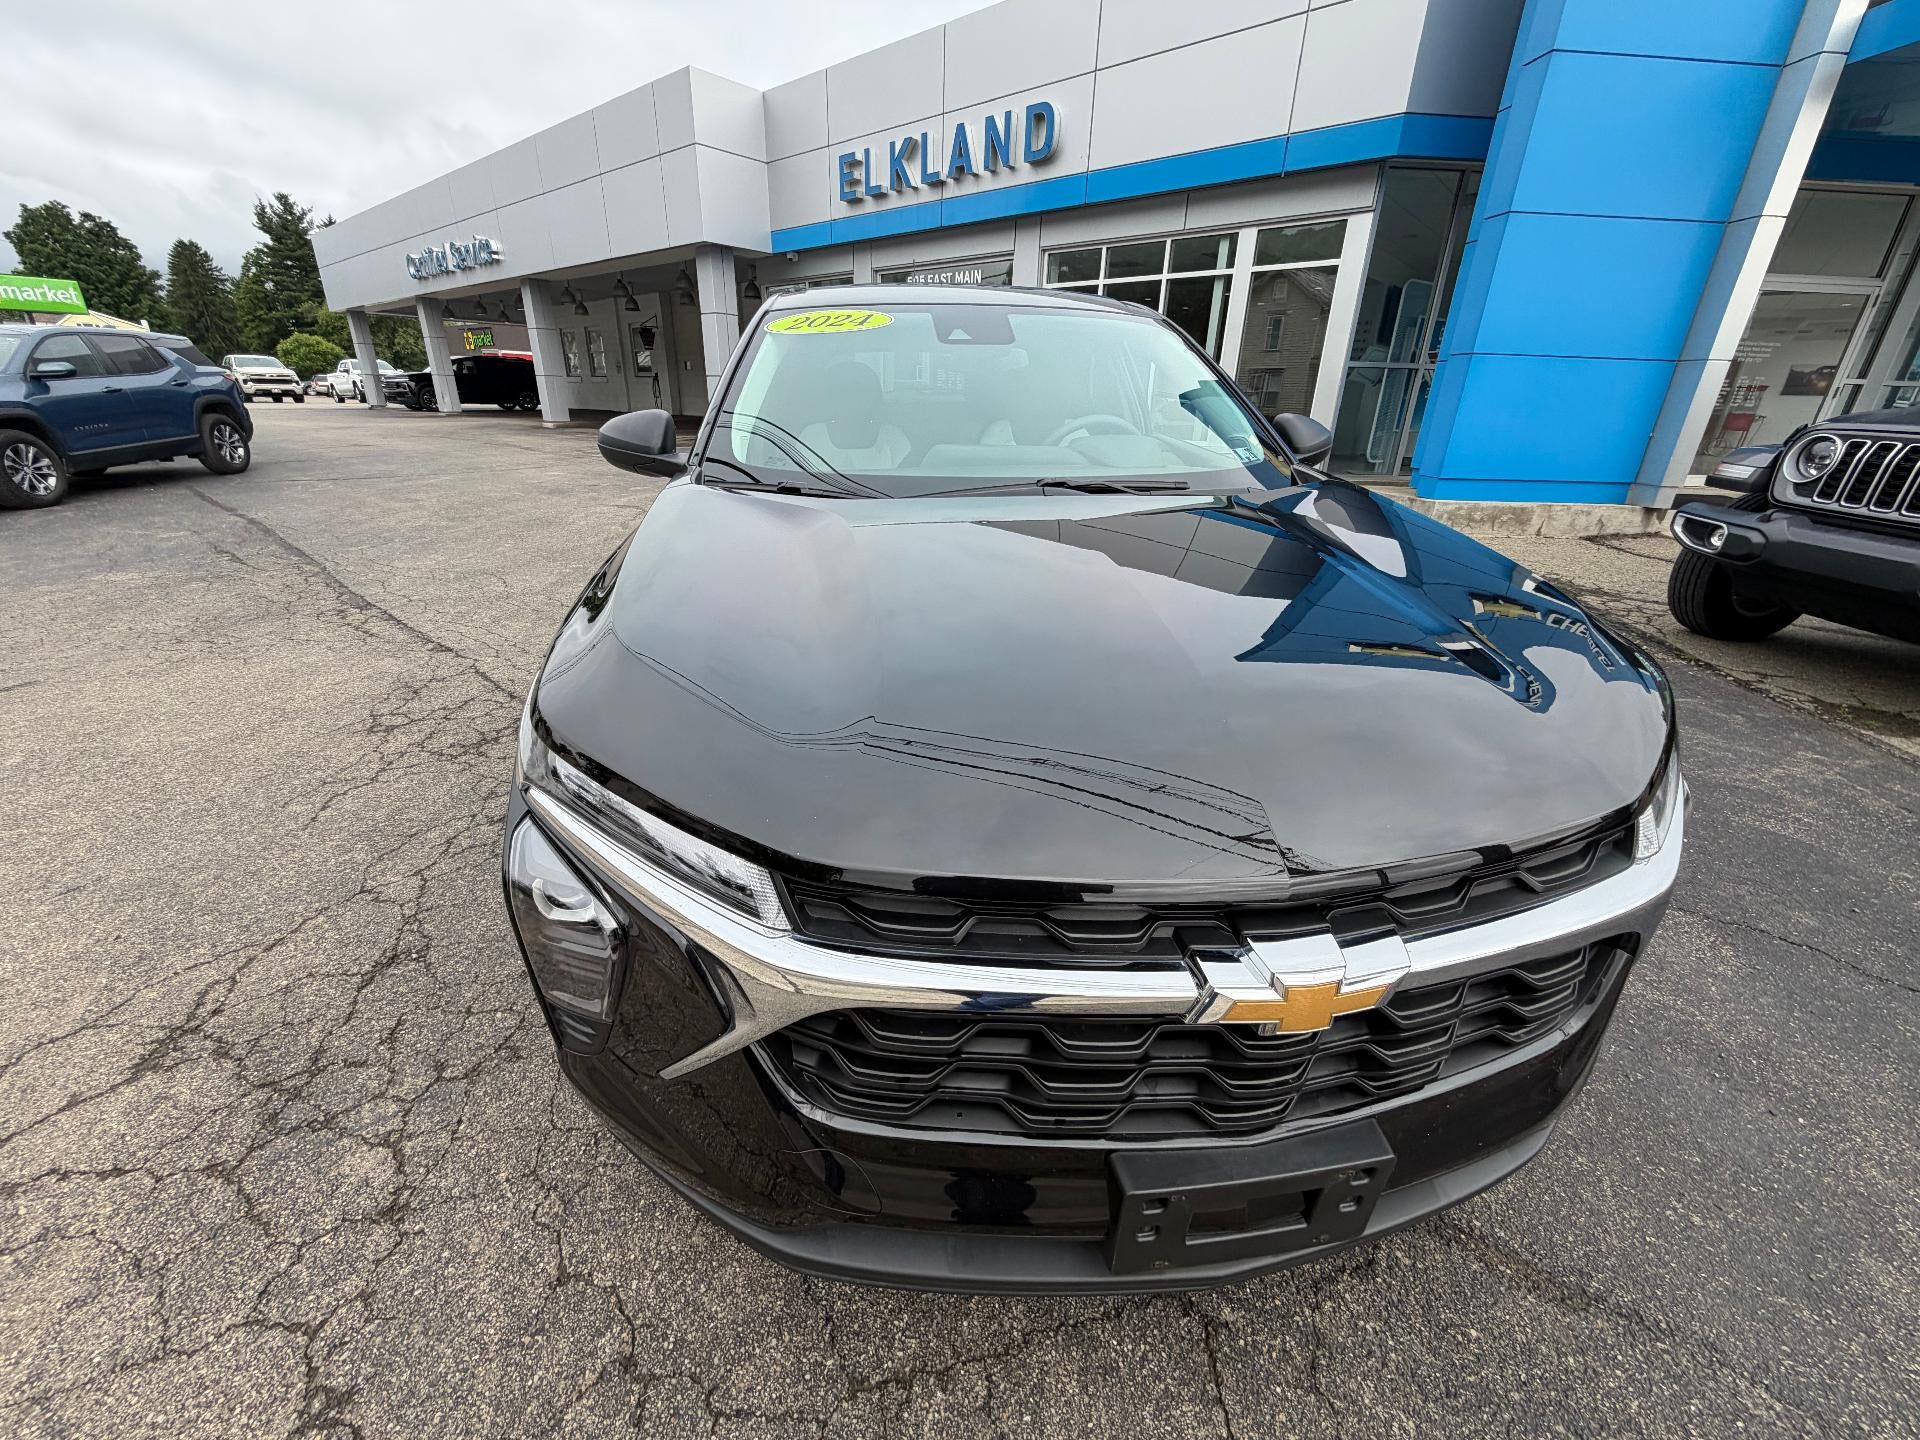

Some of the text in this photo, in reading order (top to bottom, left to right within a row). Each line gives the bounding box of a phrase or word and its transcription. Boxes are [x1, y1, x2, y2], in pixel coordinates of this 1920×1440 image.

[838, 101, 1060, 202] ELKLAND
[927, 273, 953, 284] EAST
[954, 269, 982, 284] MAIN
[0, 284, 83, 305] market
[784, 314, 874, 331] 2024
